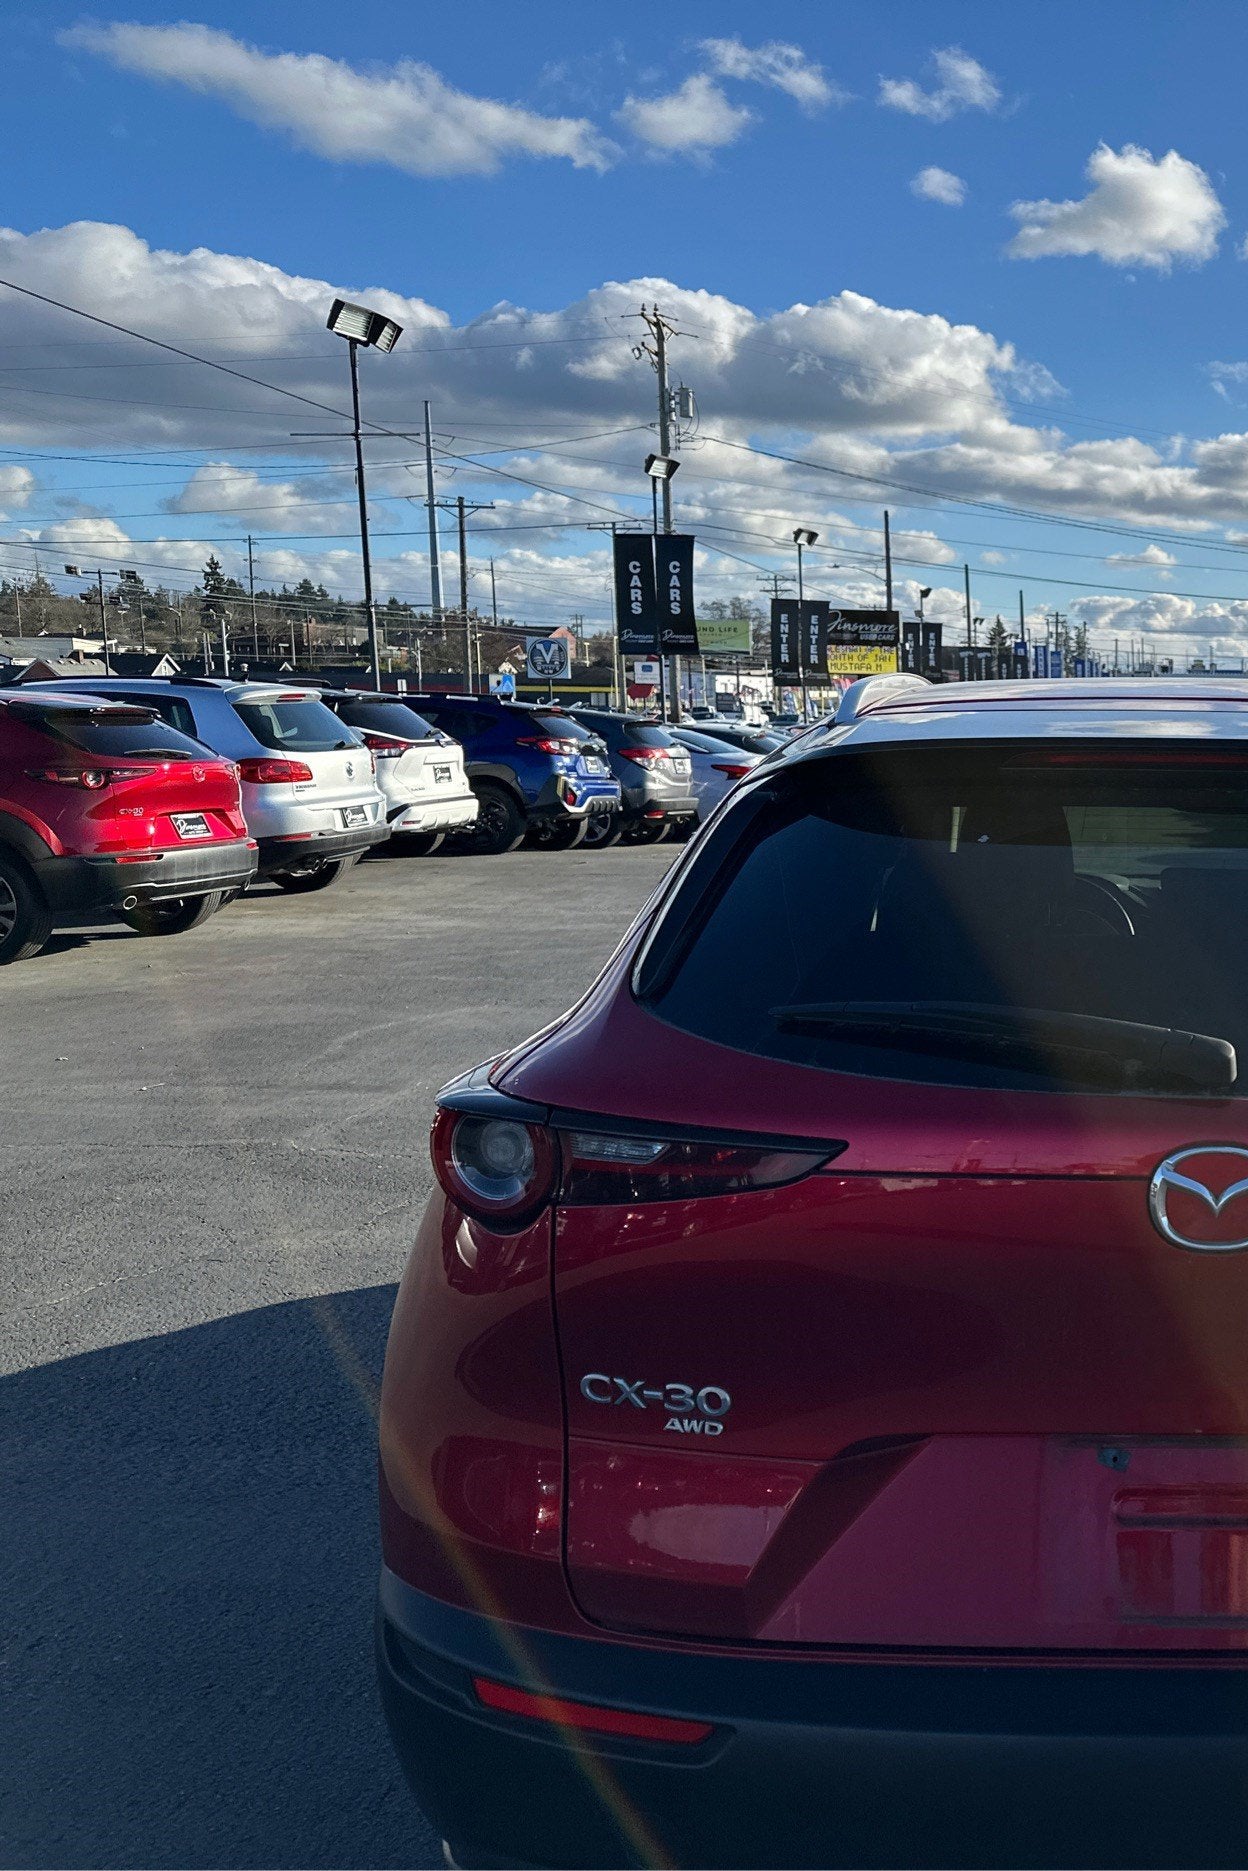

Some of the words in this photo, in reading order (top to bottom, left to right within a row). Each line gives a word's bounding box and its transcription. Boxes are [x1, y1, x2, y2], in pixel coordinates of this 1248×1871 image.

[628, 560, 643, 615] CARS
[668, 560, 682, 615] CARS
[780, 613, 790, 663] ENTER
[810, 614, 819, 664] ENTER
[877, 633, 896, 641] CARS
[579, 1373, 732, 1417] CX-30
[662, 1417, 724, 1436] AWD
